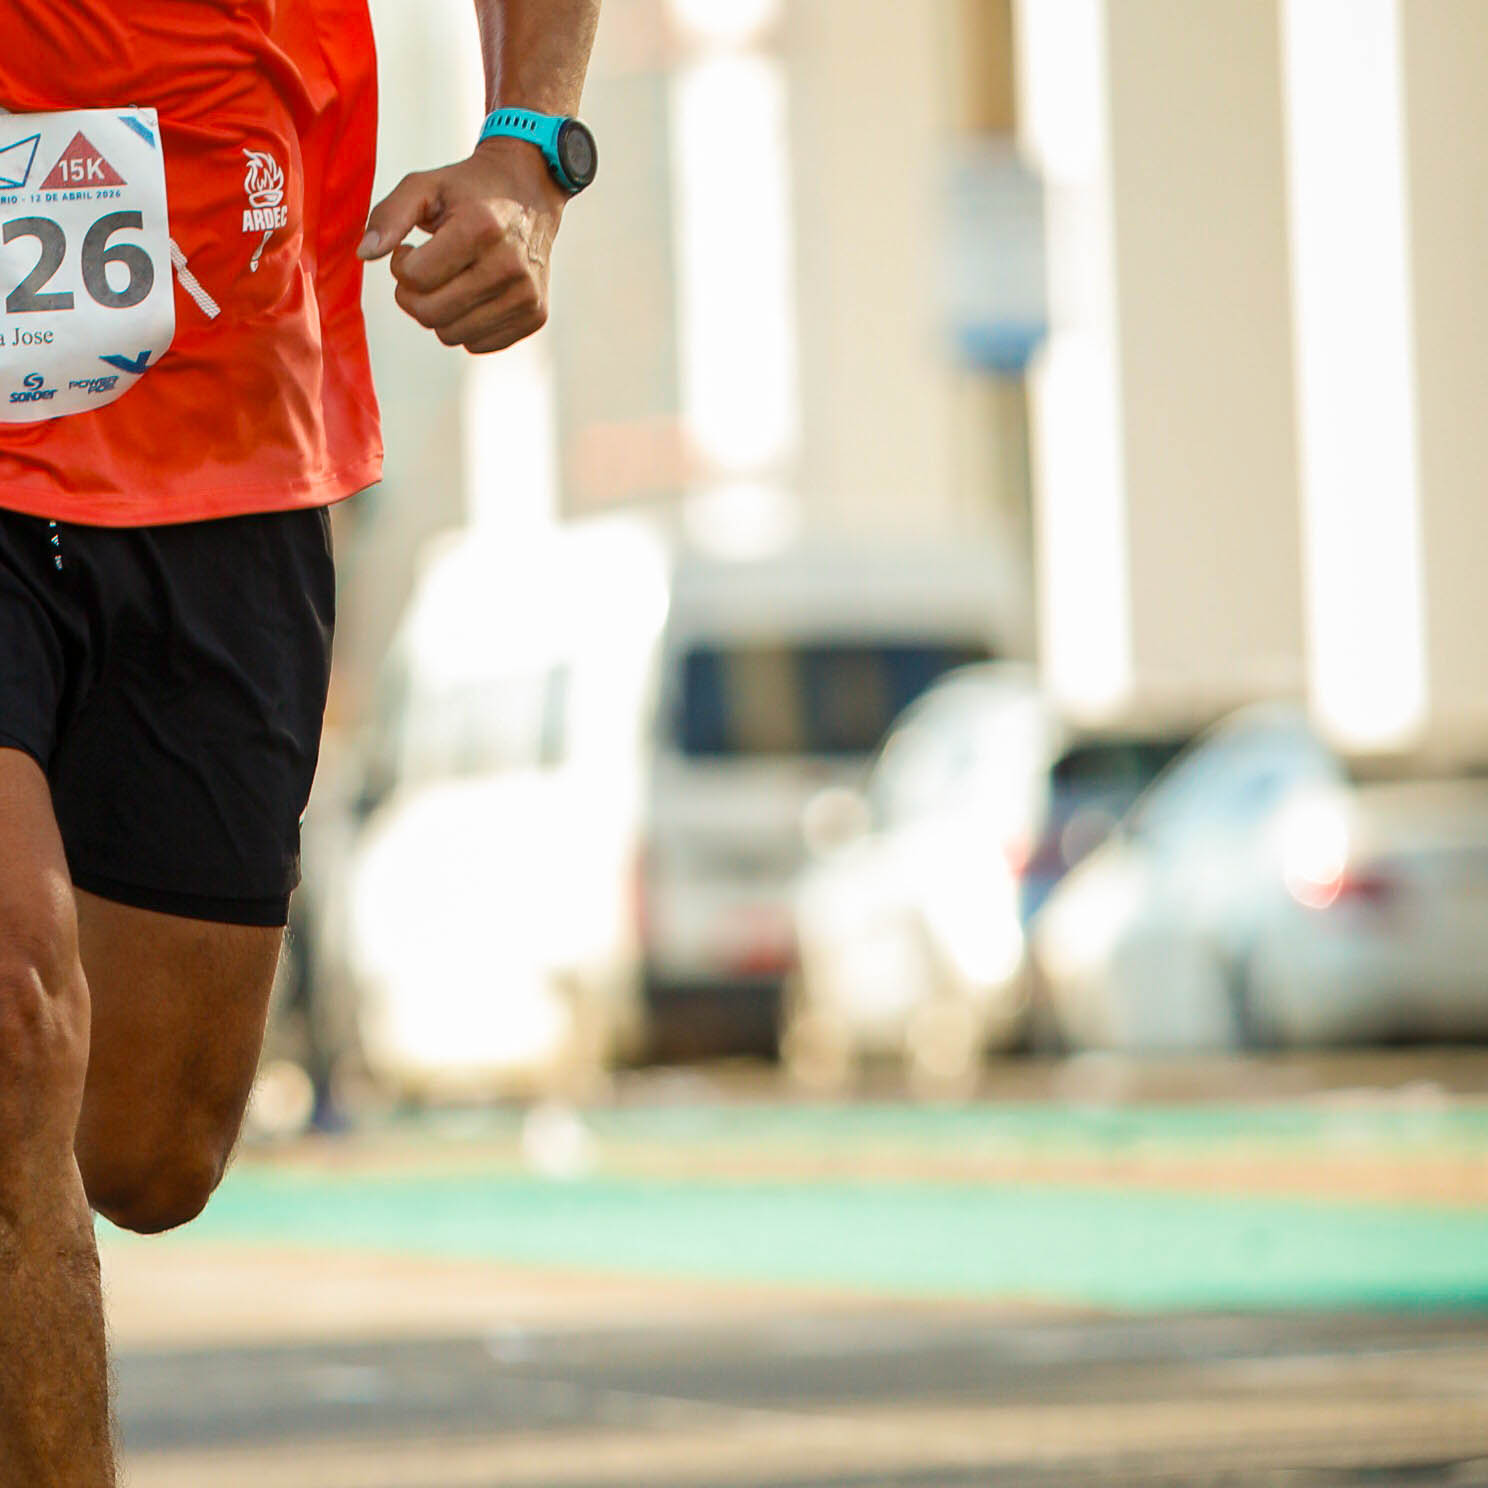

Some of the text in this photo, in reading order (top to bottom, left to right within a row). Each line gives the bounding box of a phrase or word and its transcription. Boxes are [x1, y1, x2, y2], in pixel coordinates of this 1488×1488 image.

[58, 158, 105, 182] 15K
[30, 193, 41, 203] 12
[45, 192, 58, 202] DE
[62, 190, 93, 201] ABRIL
[96, 189, 121, 200] 2026
[242, 205, 288, 232] ARDEC
[12, 327, 54, 346] Jose
